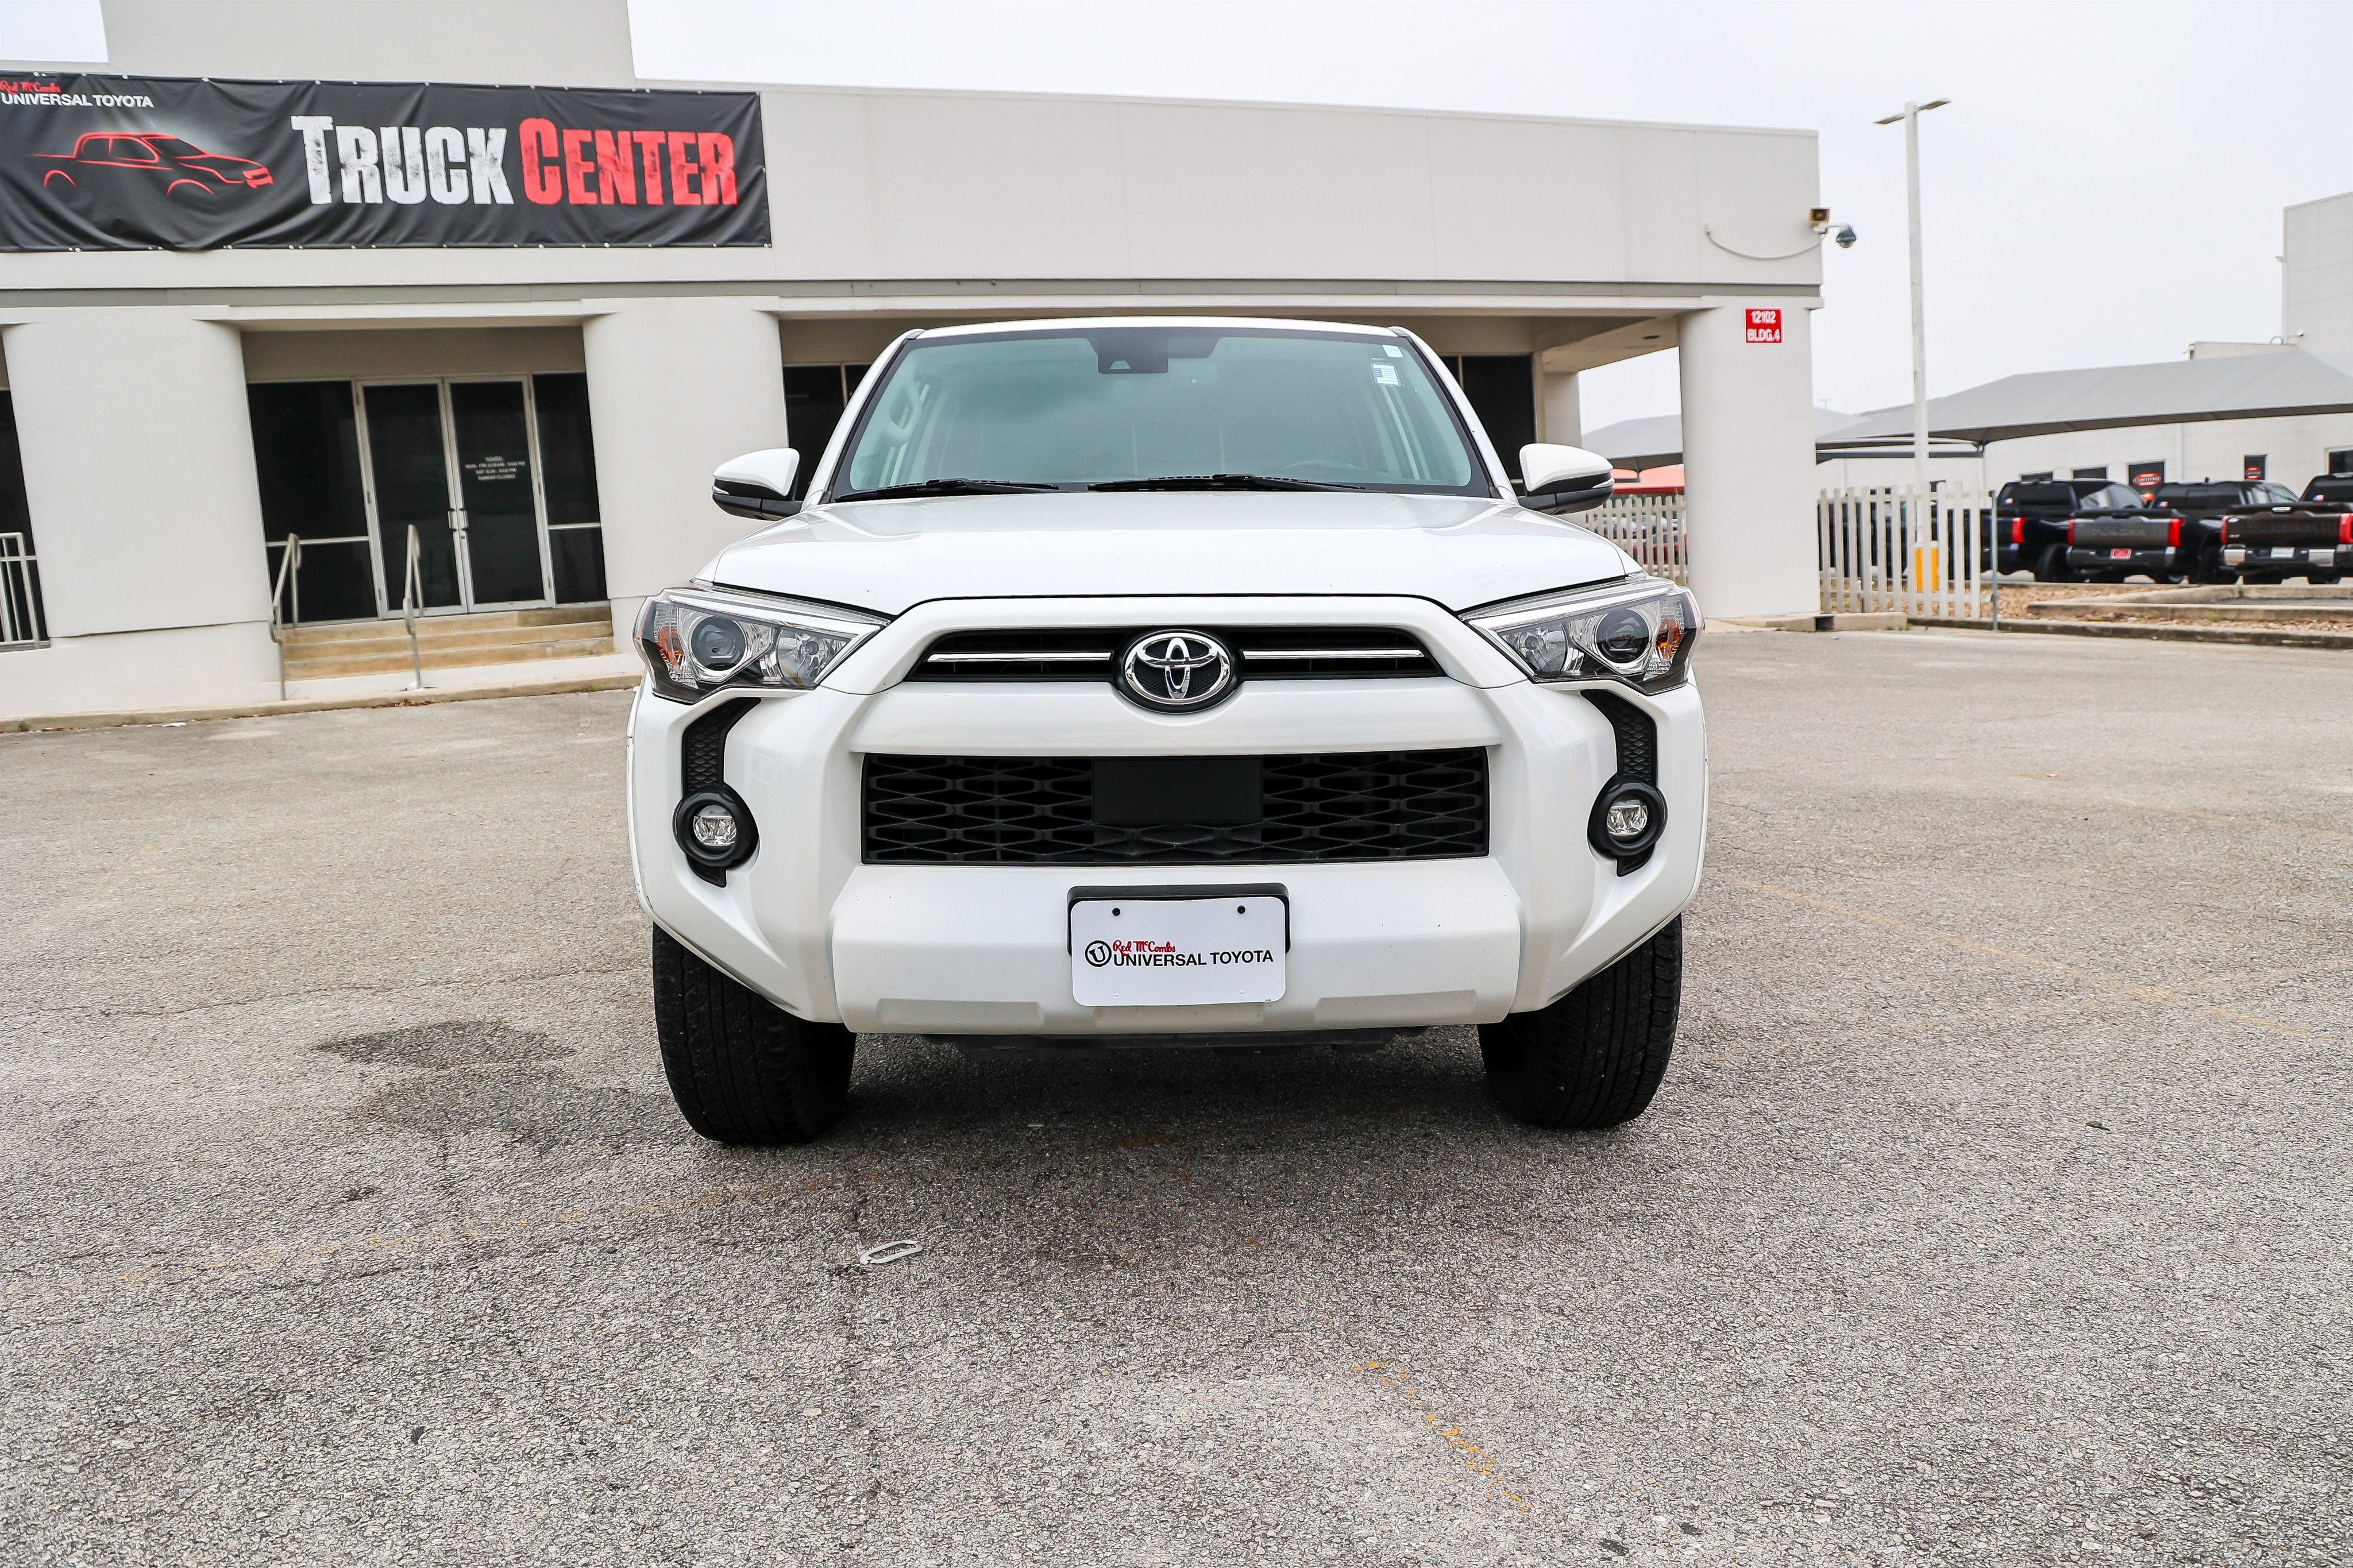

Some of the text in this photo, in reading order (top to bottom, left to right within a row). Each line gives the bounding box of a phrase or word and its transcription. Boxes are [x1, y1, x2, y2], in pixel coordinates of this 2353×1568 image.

[1, 92, 155, 108] UNIVERSAL TOYOTA
[290, 115, 738, 206] TRUCK CENTER
[1751, 310, 1776, 325] 12102
[1113, 940, 1176, 956] Red McCombs
[1113, 950, 1274, 967] UNIVERSAL TOYOTA
